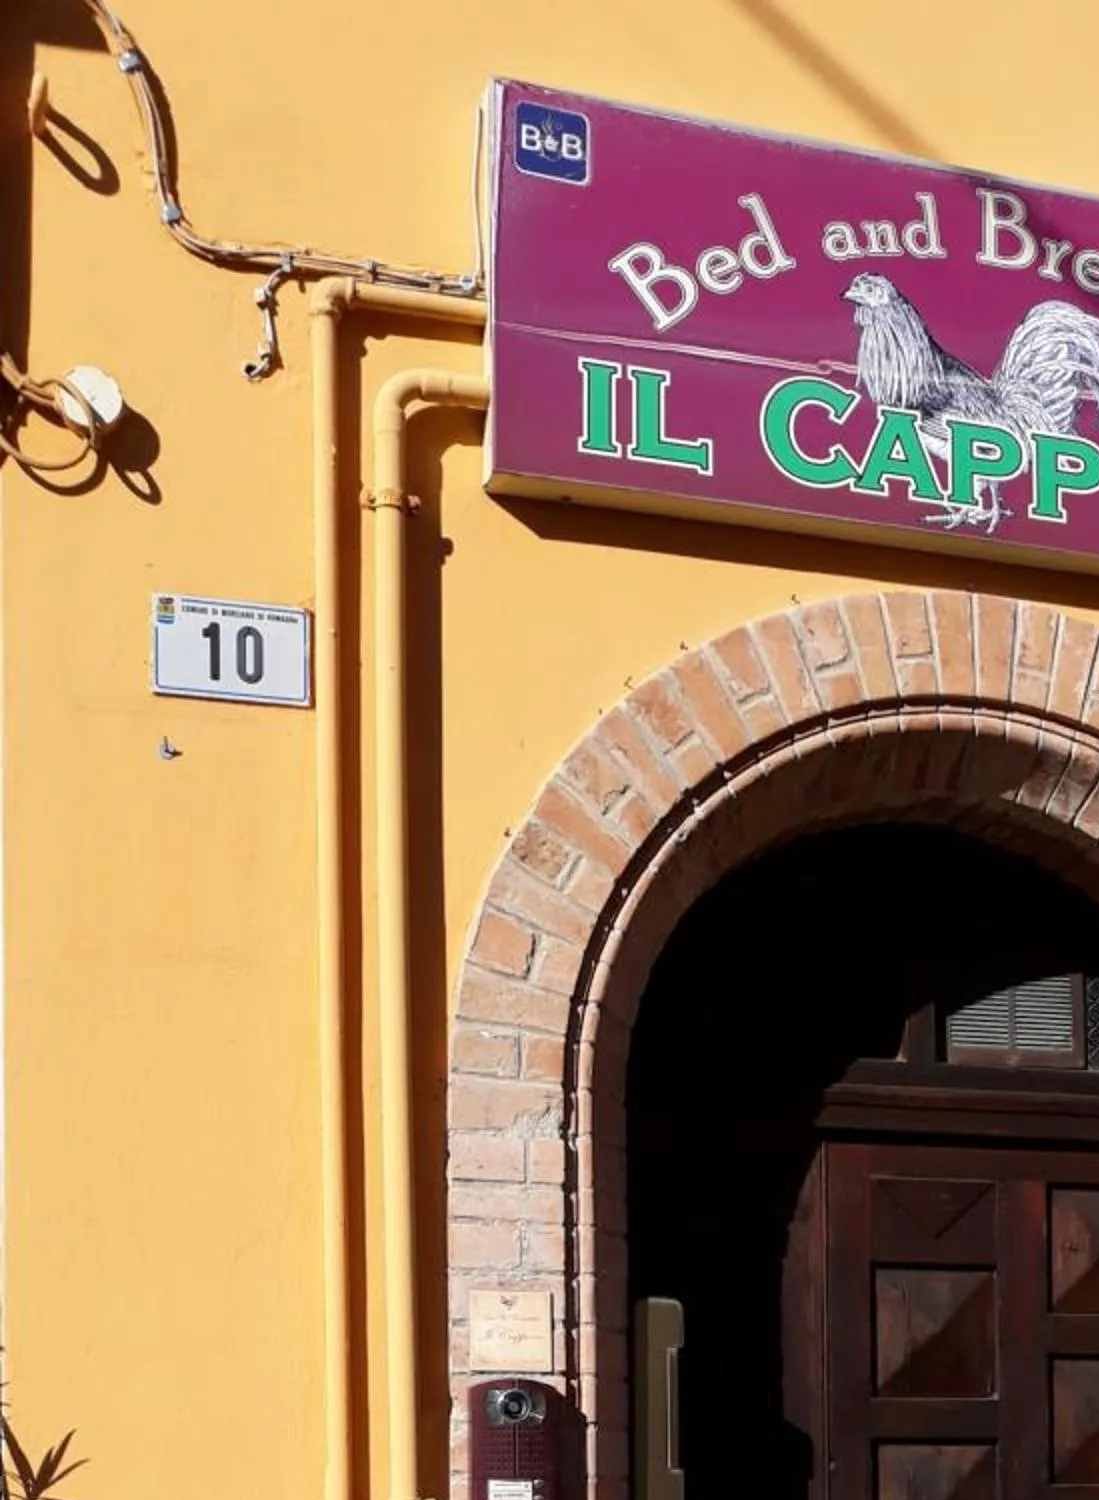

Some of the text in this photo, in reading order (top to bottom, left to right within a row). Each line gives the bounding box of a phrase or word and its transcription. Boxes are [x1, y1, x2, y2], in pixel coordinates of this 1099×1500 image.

[608, 192, 796, 333] Bed
[821, 191, 948, 262] and
[578, 356, 713, 476] IL
[202, 621, 264, 684] 10
